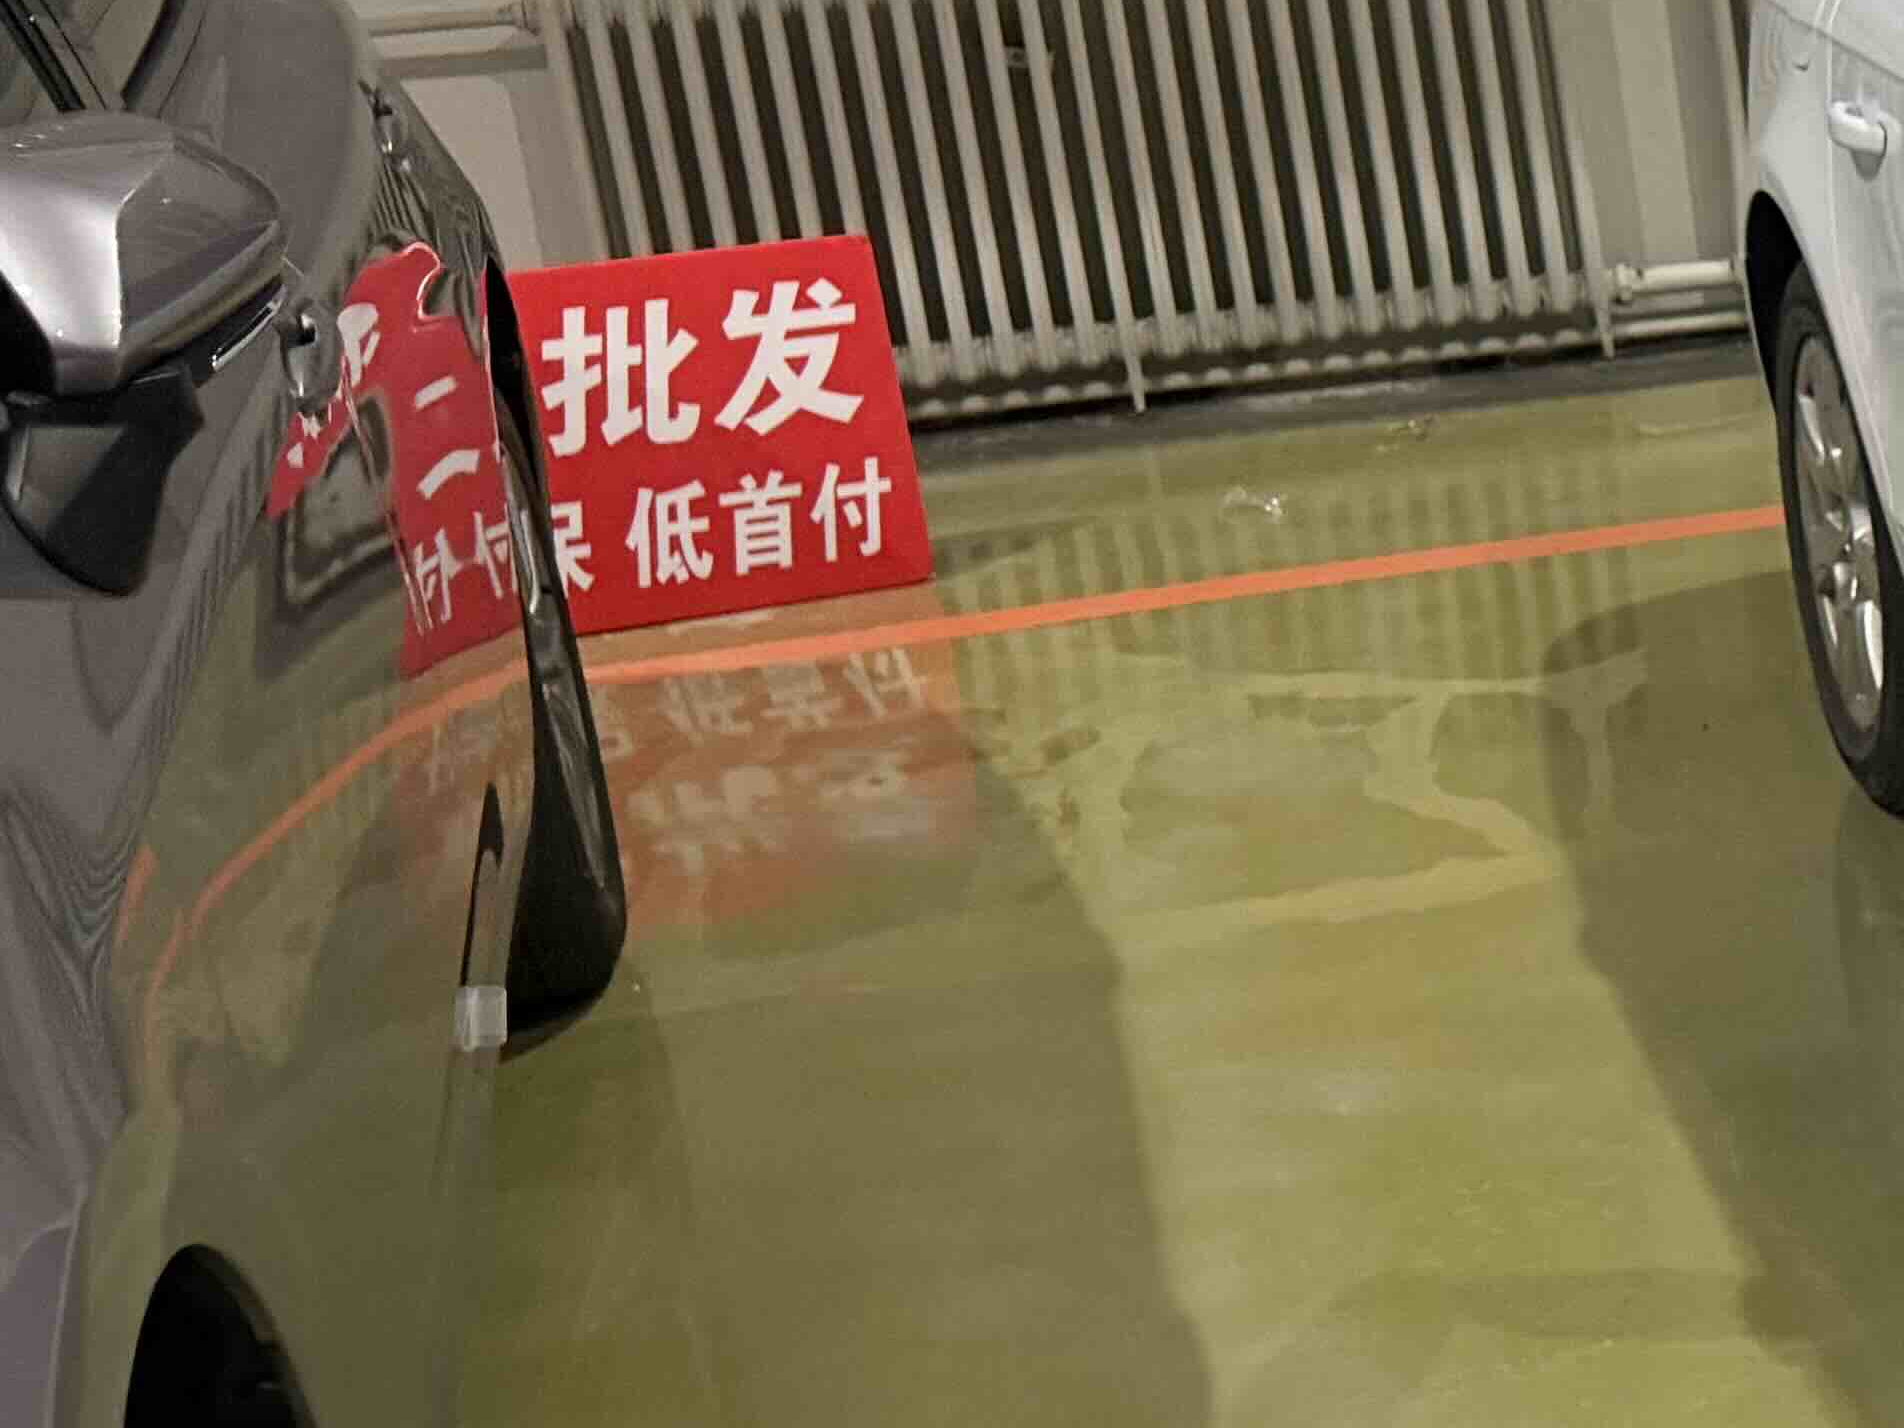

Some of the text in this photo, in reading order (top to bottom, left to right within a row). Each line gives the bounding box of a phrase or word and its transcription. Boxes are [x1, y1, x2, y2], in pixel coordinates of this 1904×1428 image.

[541, 278, 864, 456] 批发
[625, 457, 892, 588] 低首付
